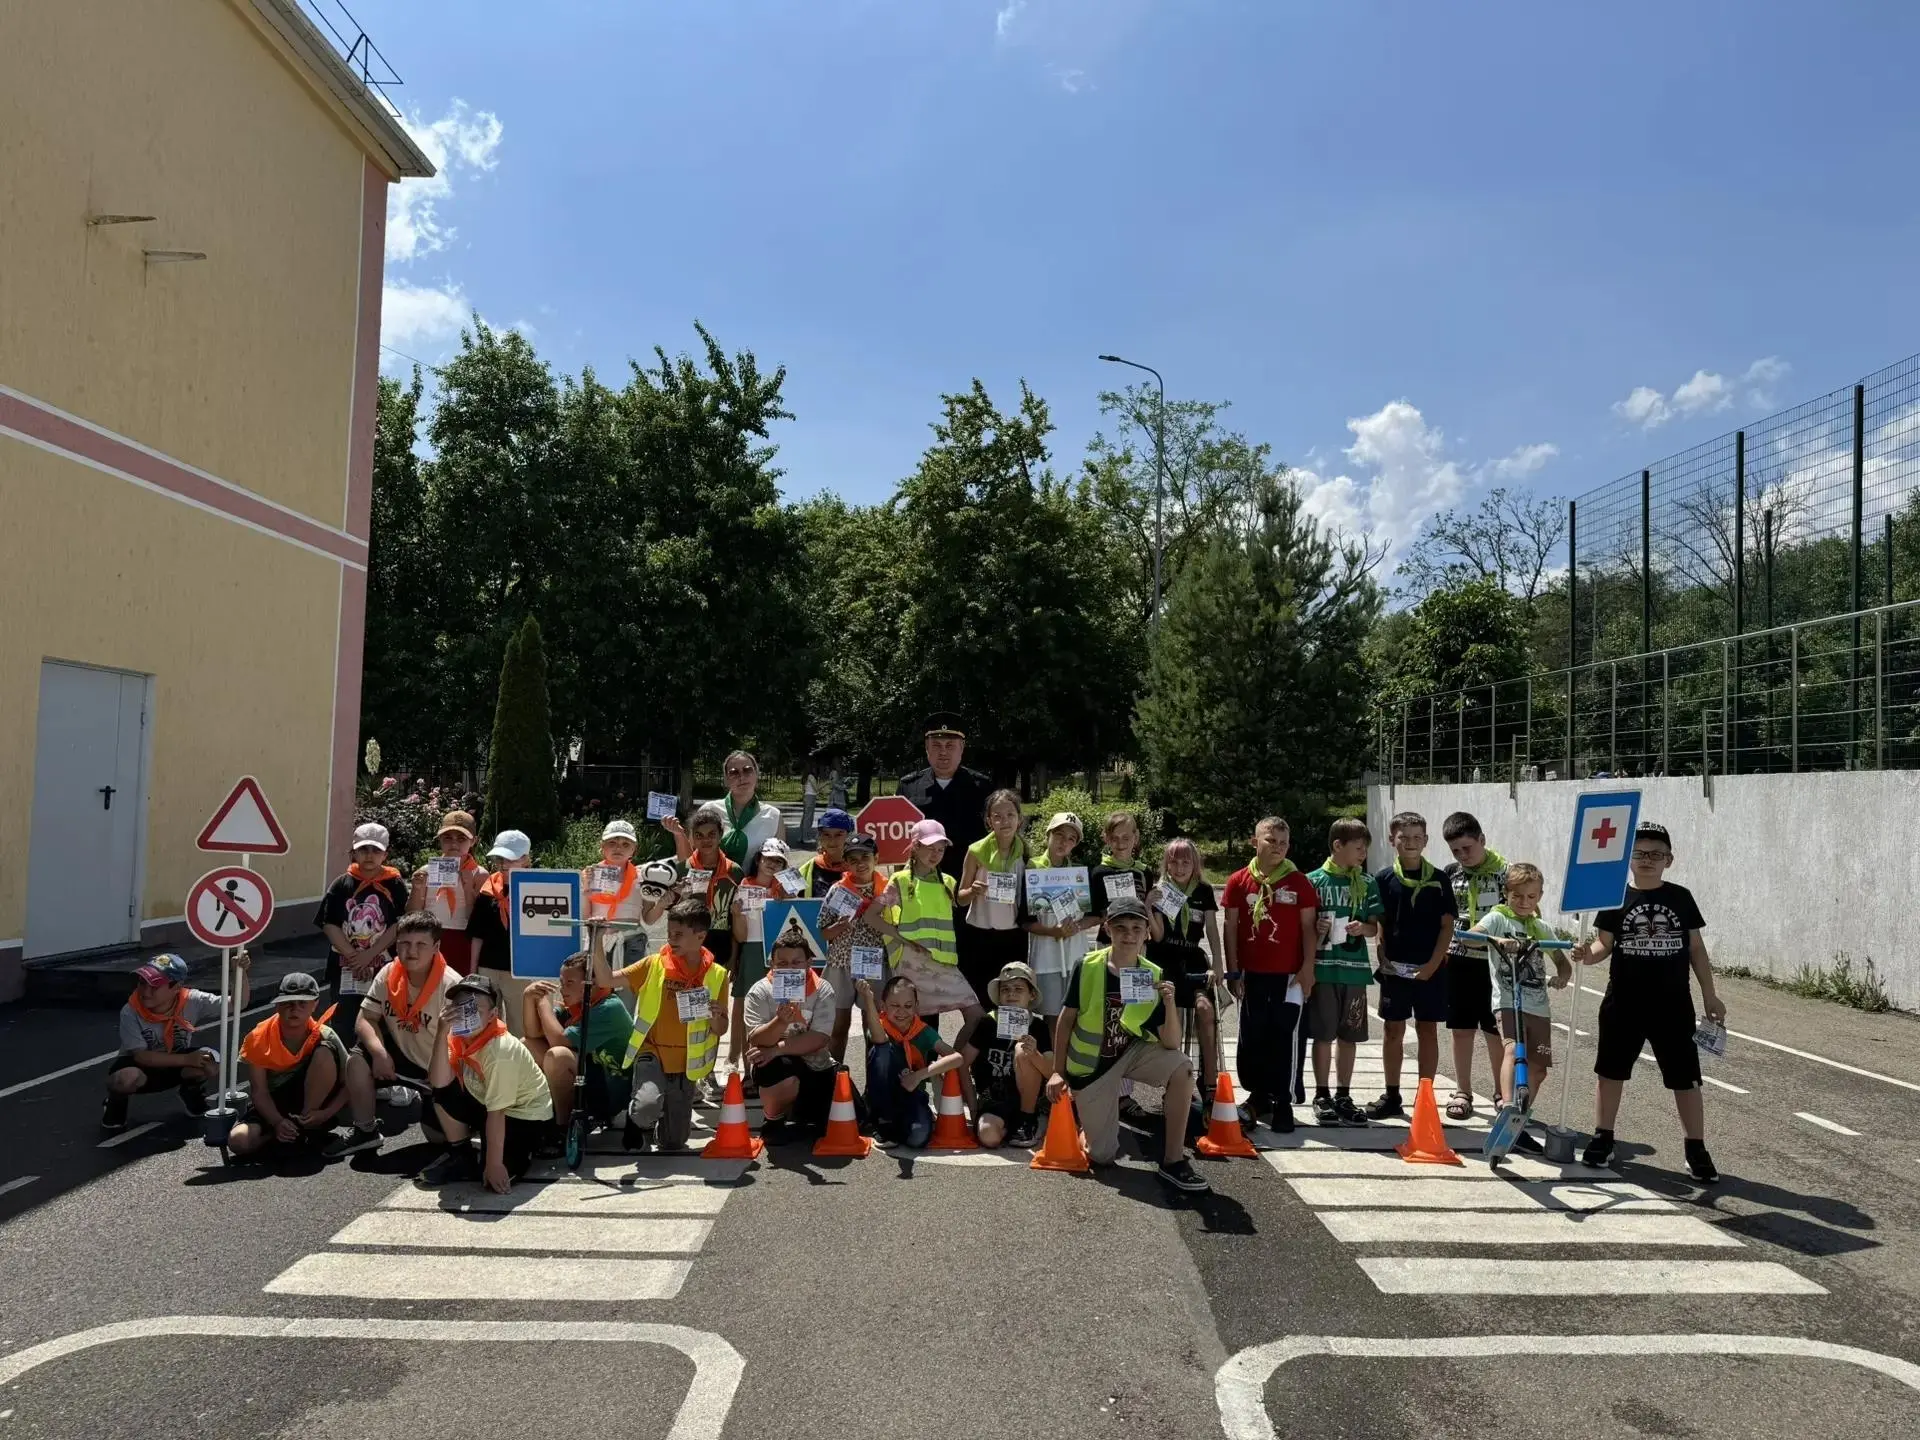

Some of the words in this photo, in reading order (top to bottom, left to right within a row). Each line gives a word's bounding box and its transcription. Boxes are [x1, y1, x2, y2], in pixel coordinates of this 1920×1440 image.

[864, 821, 916, 841] STOP
[1622, 903, 1650, 931] STREET
[1653, 903, 1681, 928] STYLE
